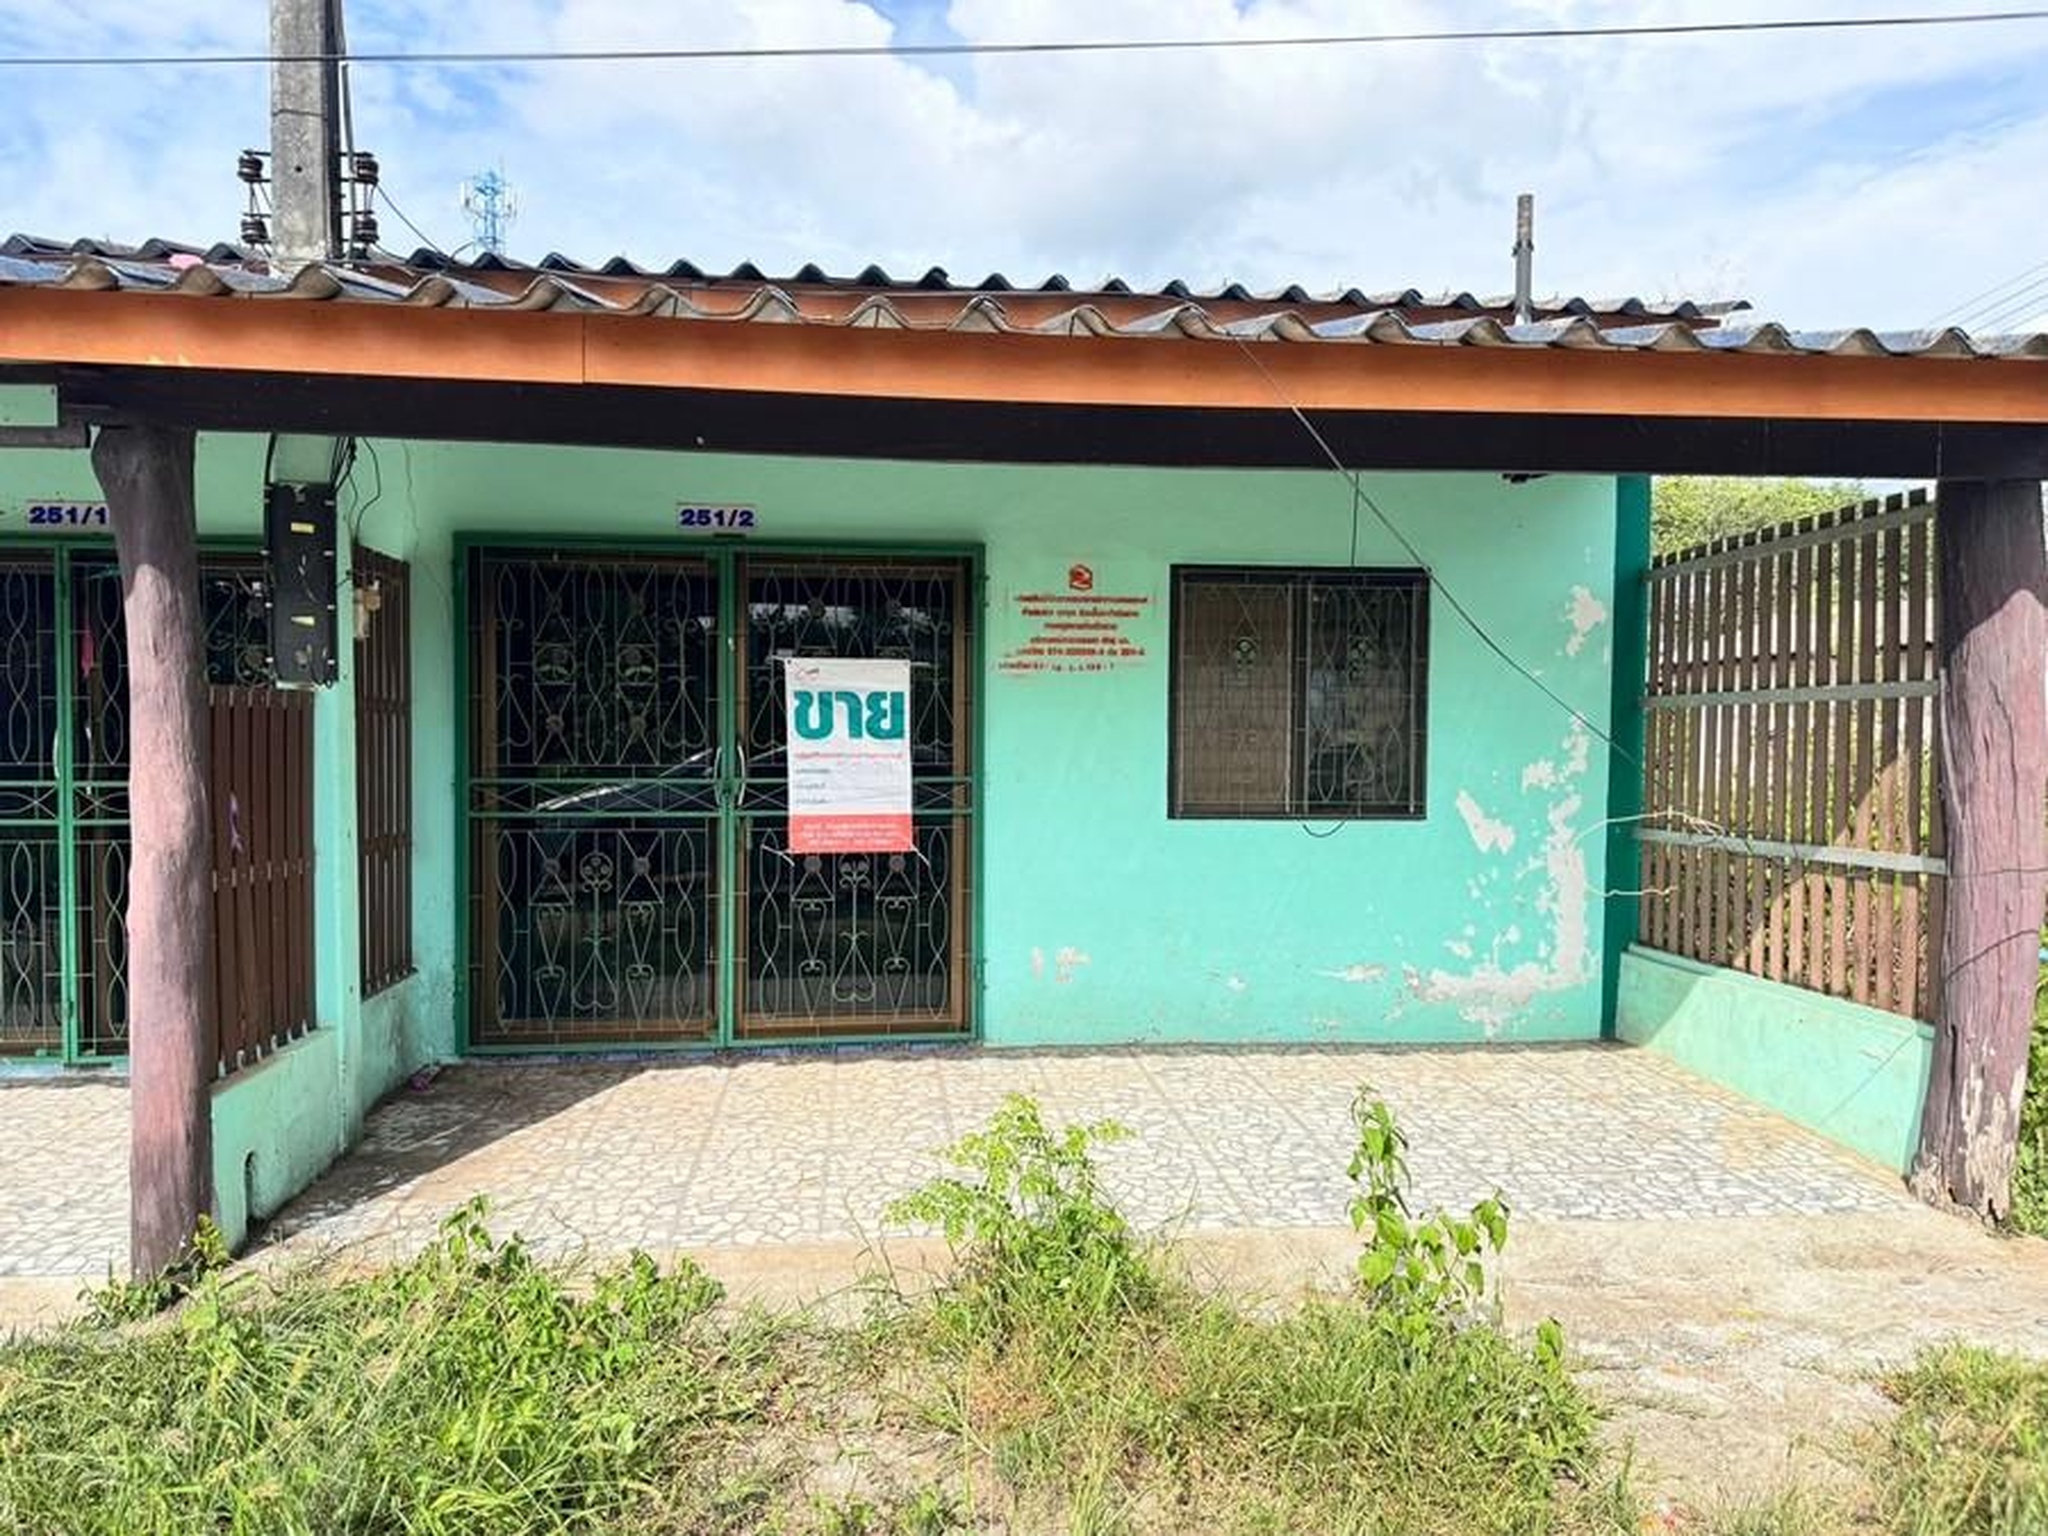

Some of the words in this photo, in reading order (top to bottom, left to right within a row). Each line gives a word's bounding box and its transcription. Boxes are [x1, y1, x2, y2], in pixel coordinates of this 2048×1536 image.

[28, 505, 107, 525] 251/1
[680, 508, 755, 527] 251/2
[793, 690, 905, 740] ขาย
